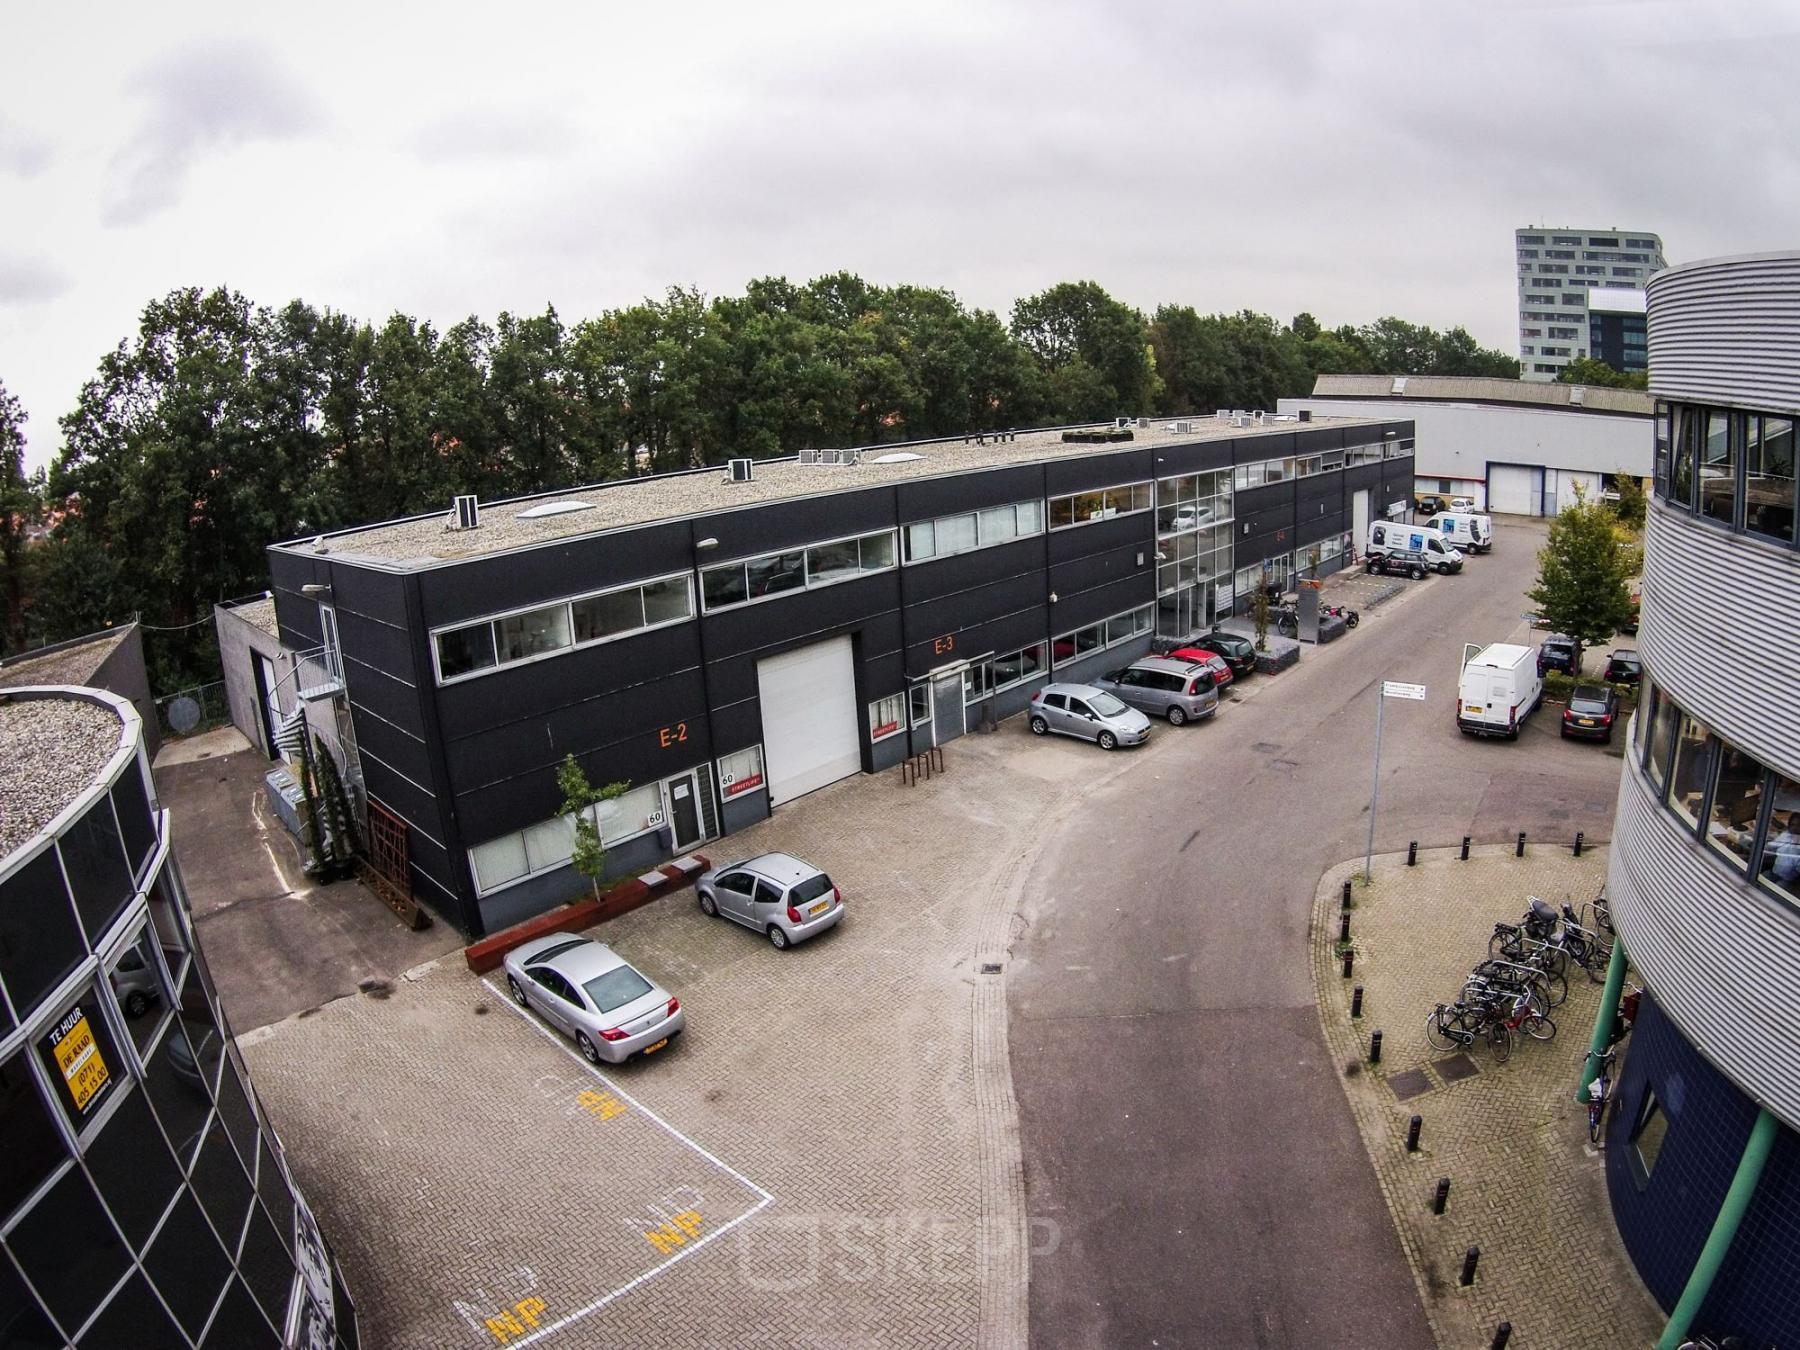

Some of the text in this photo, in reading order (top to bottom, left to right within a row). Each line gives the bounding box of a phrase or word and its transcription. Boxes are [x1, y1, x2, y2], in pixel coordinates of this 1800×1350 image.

[936, 636, 953, 655] E-3
[660, 723, 688, 747] E-2
[723, 774, 733, 785] 60
[649, 812, 661, 823] 60
[49, 1006, 83, 1045] TE HUUR
[63, 1034, 90, 1069] DE RAAD
[78, 1062, 96, 1087] (071)
[89, 1077, 98, 1090] 15
[96, 1066, 107, 1081] 00
[643, 1210, 703, 1254] NP
[484, 1295, 545, 1345] NP
